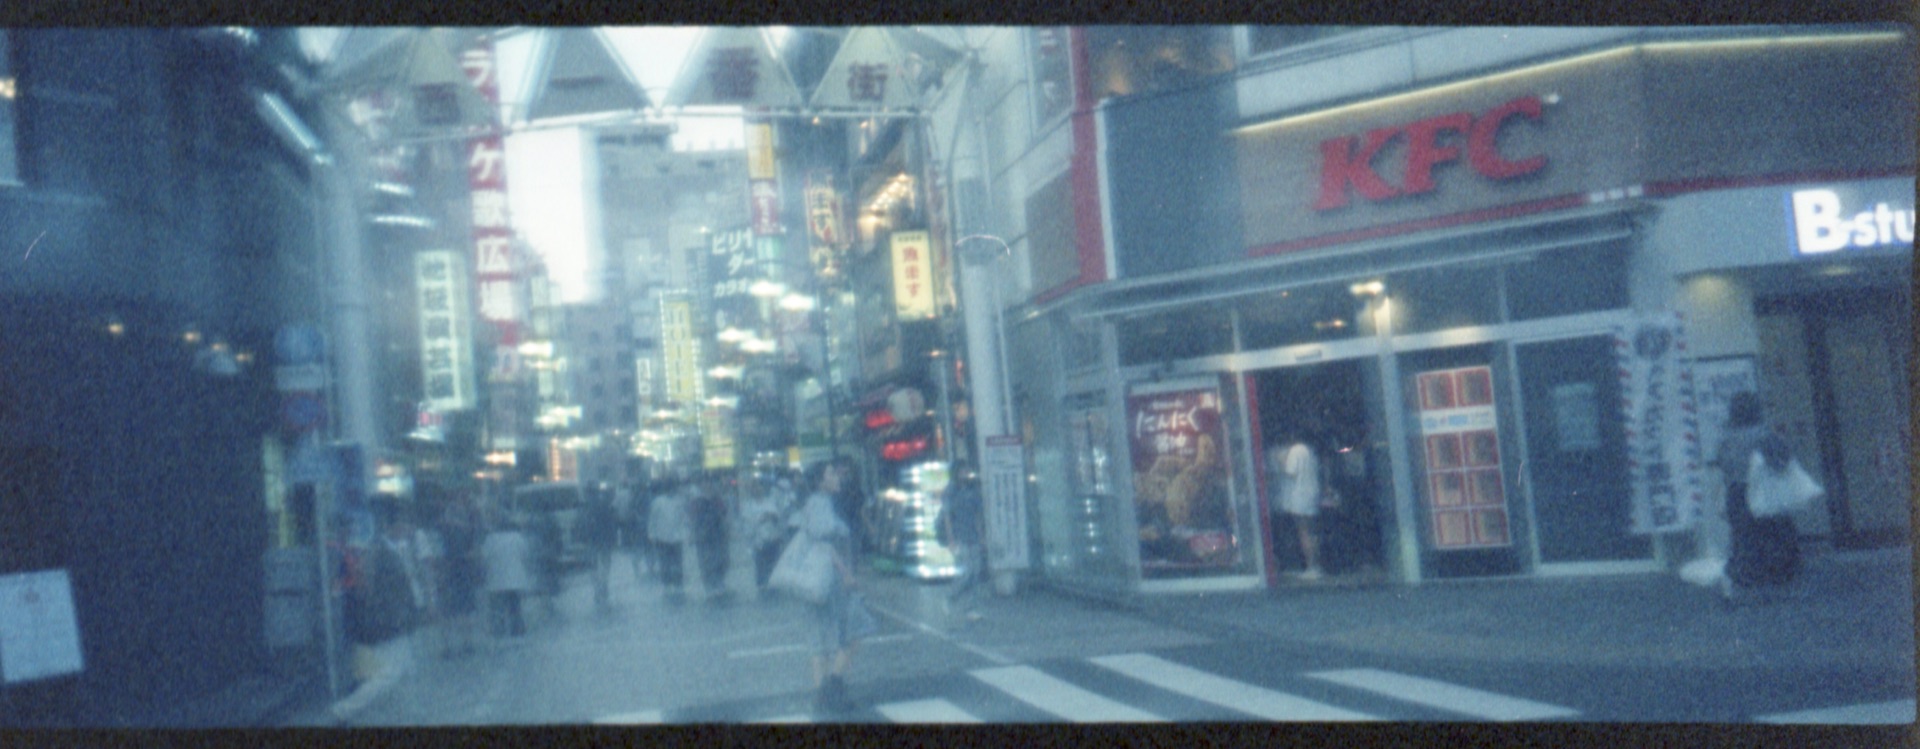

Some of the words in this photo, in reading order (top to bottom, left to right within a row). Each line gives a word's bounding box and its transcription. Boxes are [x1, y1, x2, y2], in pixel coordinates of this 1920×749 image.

[1312, 96, 1546, 211] KFC
[1136, 406, 1200, 439] にんにく
